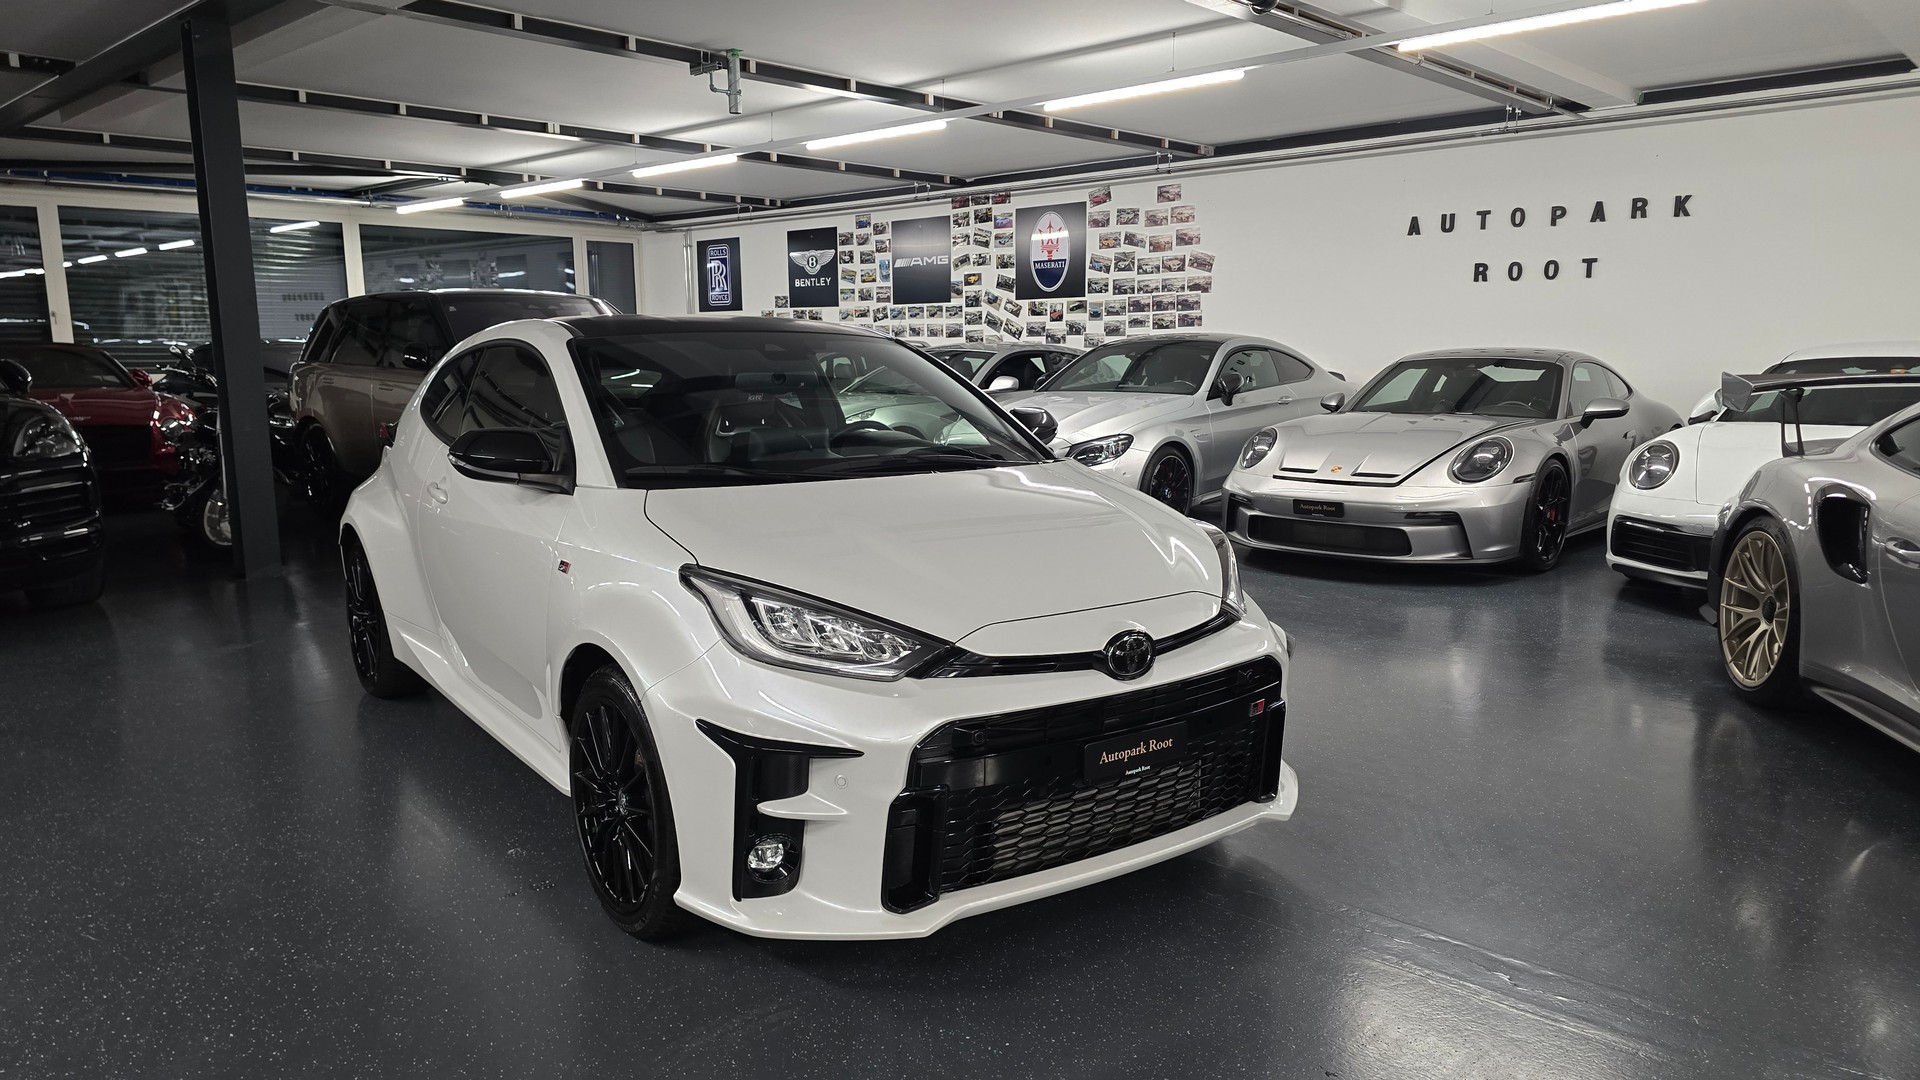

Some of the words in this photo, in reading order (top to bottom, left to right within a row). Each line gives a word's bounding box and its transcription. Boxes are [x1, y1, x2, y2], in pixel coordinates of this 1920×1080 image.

[1407, 194, 1692, 236] AUTOPARK
[710, 248, 727, 256] ROLLS
[910, 255, 949, 267] AMG
[1034, 261, 1065, 269] MASERATI
[1473, 257, 1598, 282] ROOT
[794, 277, 832, 287] BENTLEY
[1099, 741, 1147, 764] Autopark
[1148, 738, 1174, 752] Root
